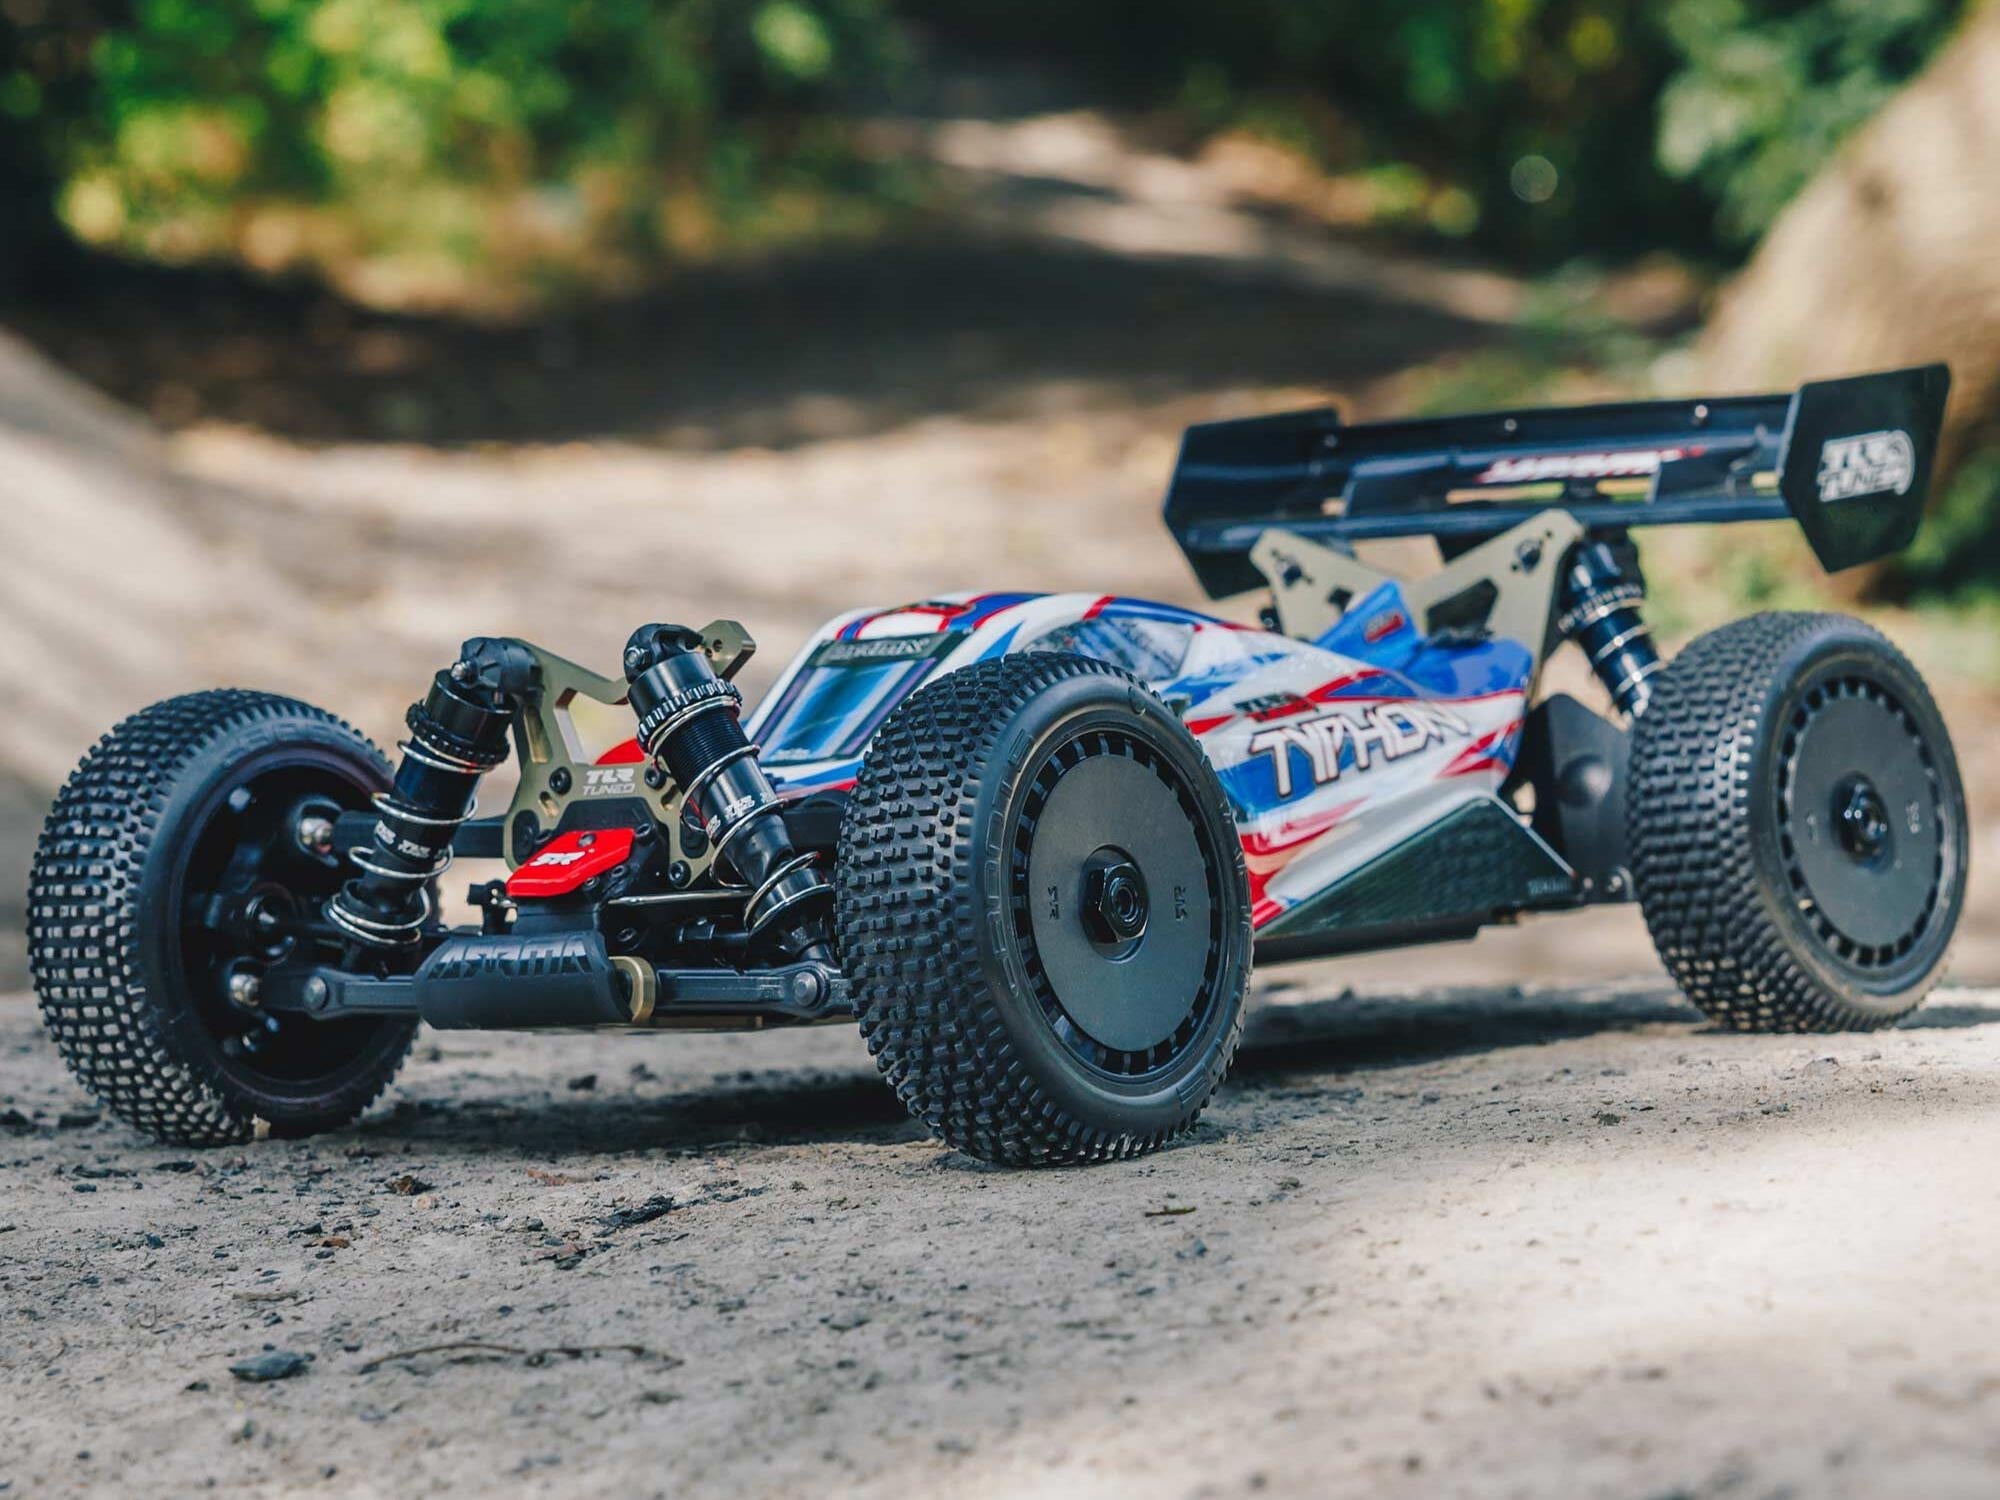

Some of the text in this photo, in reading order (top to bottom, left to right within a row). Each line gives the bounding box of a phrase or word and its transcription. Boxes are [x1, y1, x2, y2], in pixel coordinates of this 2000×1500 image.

[1249, 700, 1471, 788] TYPHON
[586, 768, 634, 784] TLR
[583, 783, 636, 796] TUNED
